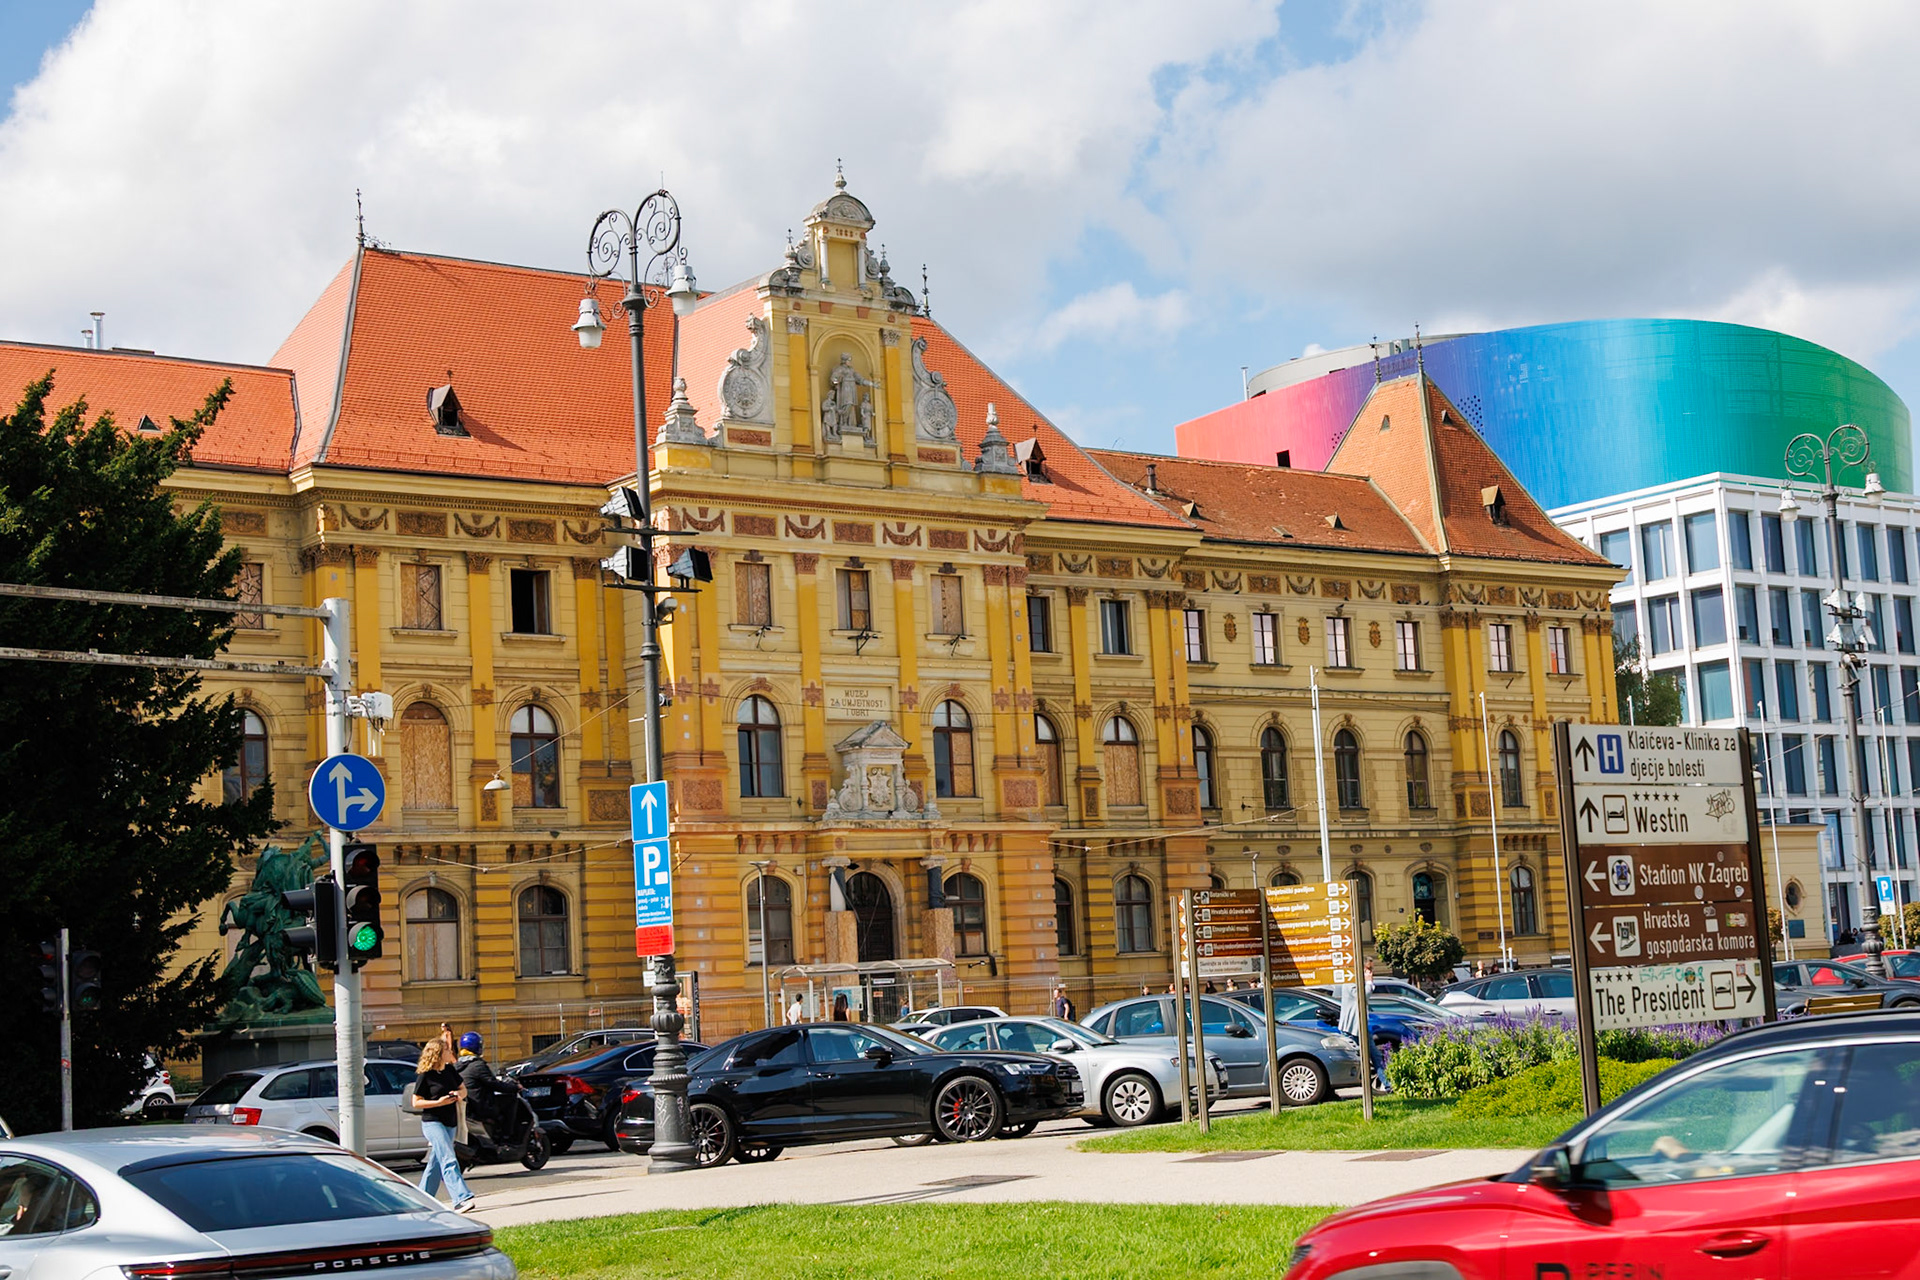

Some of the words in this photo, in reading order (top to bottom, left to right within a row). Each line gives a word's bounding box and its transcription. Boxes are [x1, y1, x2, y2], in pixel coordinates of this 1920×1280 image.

[830, 698, 840, 706] ZA
[841, 699, 884, 708] UMJETNOST
[844, 689, 869, 698] MUZEJ
[851, 708, 870, 717] OBRT
[1724, 737, 1737, 751] za
[1630, 758, 1664, 781] dječje
[1667, 758, 1705, 777] bolesti
[1633, 806, 1689, 833] Westin
[643, 846, 661, 886] P
[1639, 863, 1686, 886] Stadion
[1688, 862, 1706, 884] NK
[1708, 861, 1749, 888] Zagreb
[1880, 880, 1889, 897] P
[1643, 909, 1690, 929] Hrvatska
[1646, 934, 1714, 959] gospodarska
[1717, 932, 1755, 951] komora
[1595, 987, 1626, 1017] The
[1632, 982, 1706, 1014] President
[313, 1251, 430, 1270] PORSCHE
